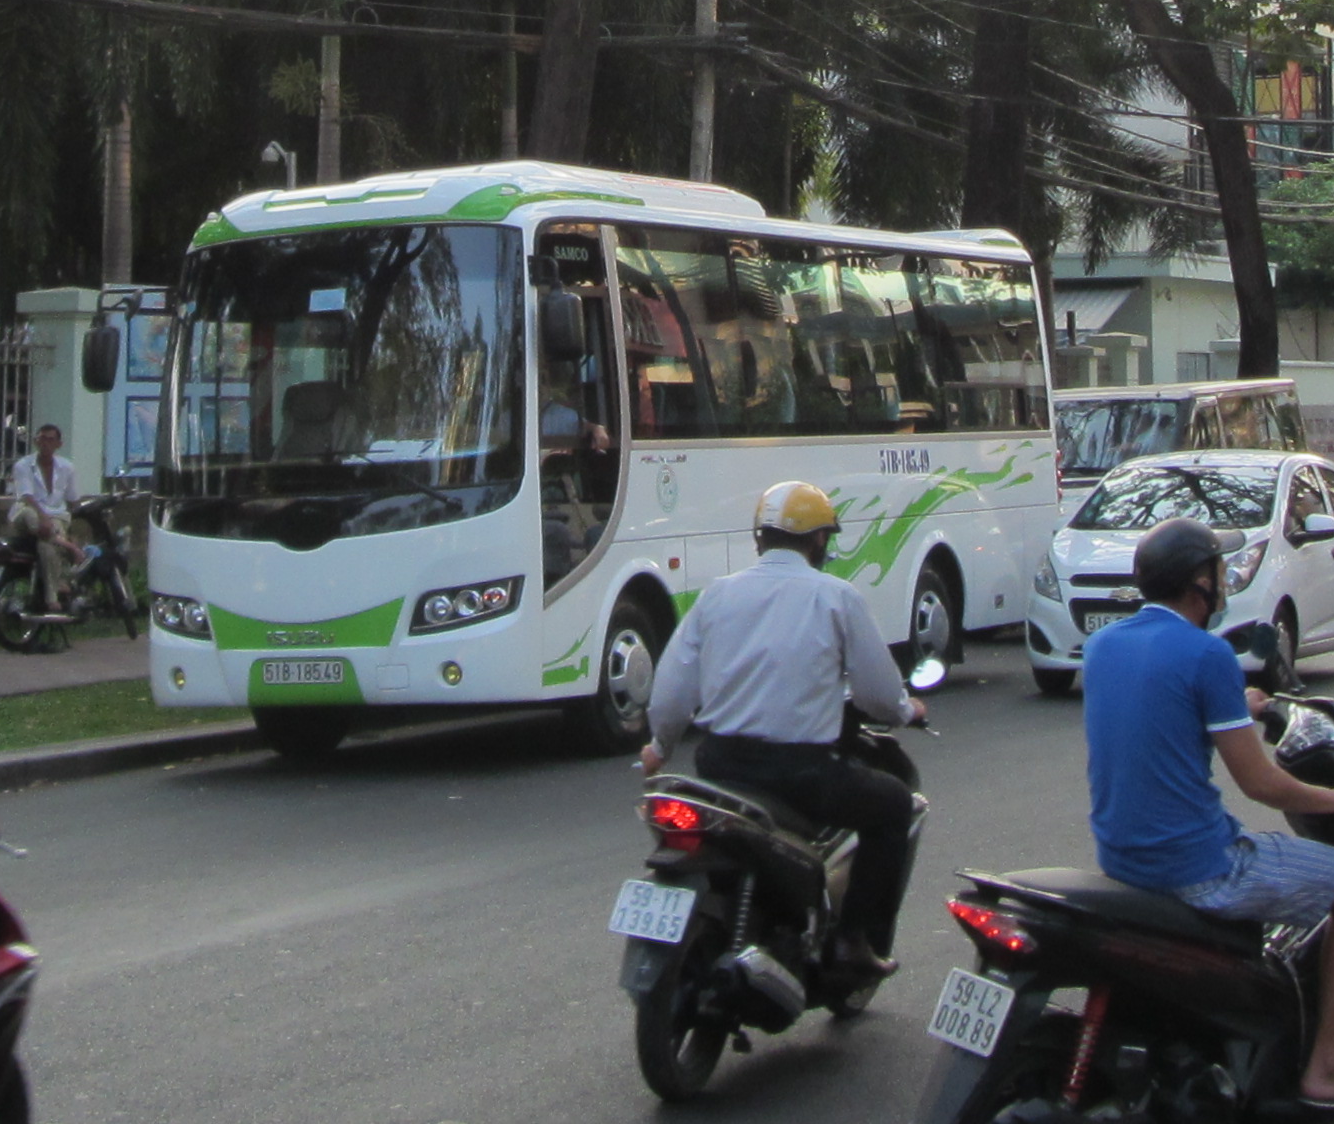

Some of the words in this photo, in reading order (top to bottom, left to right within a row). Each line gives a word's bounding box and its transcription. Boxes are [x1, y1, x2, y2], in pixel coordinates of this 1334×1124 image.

[554, 245, 589, 262] SAMCO
[267, 630, 335, 645] ISUZU
[952, 976, 1003, 1018] 59-L2
[935, 1004, 996, 1048] 008.89
